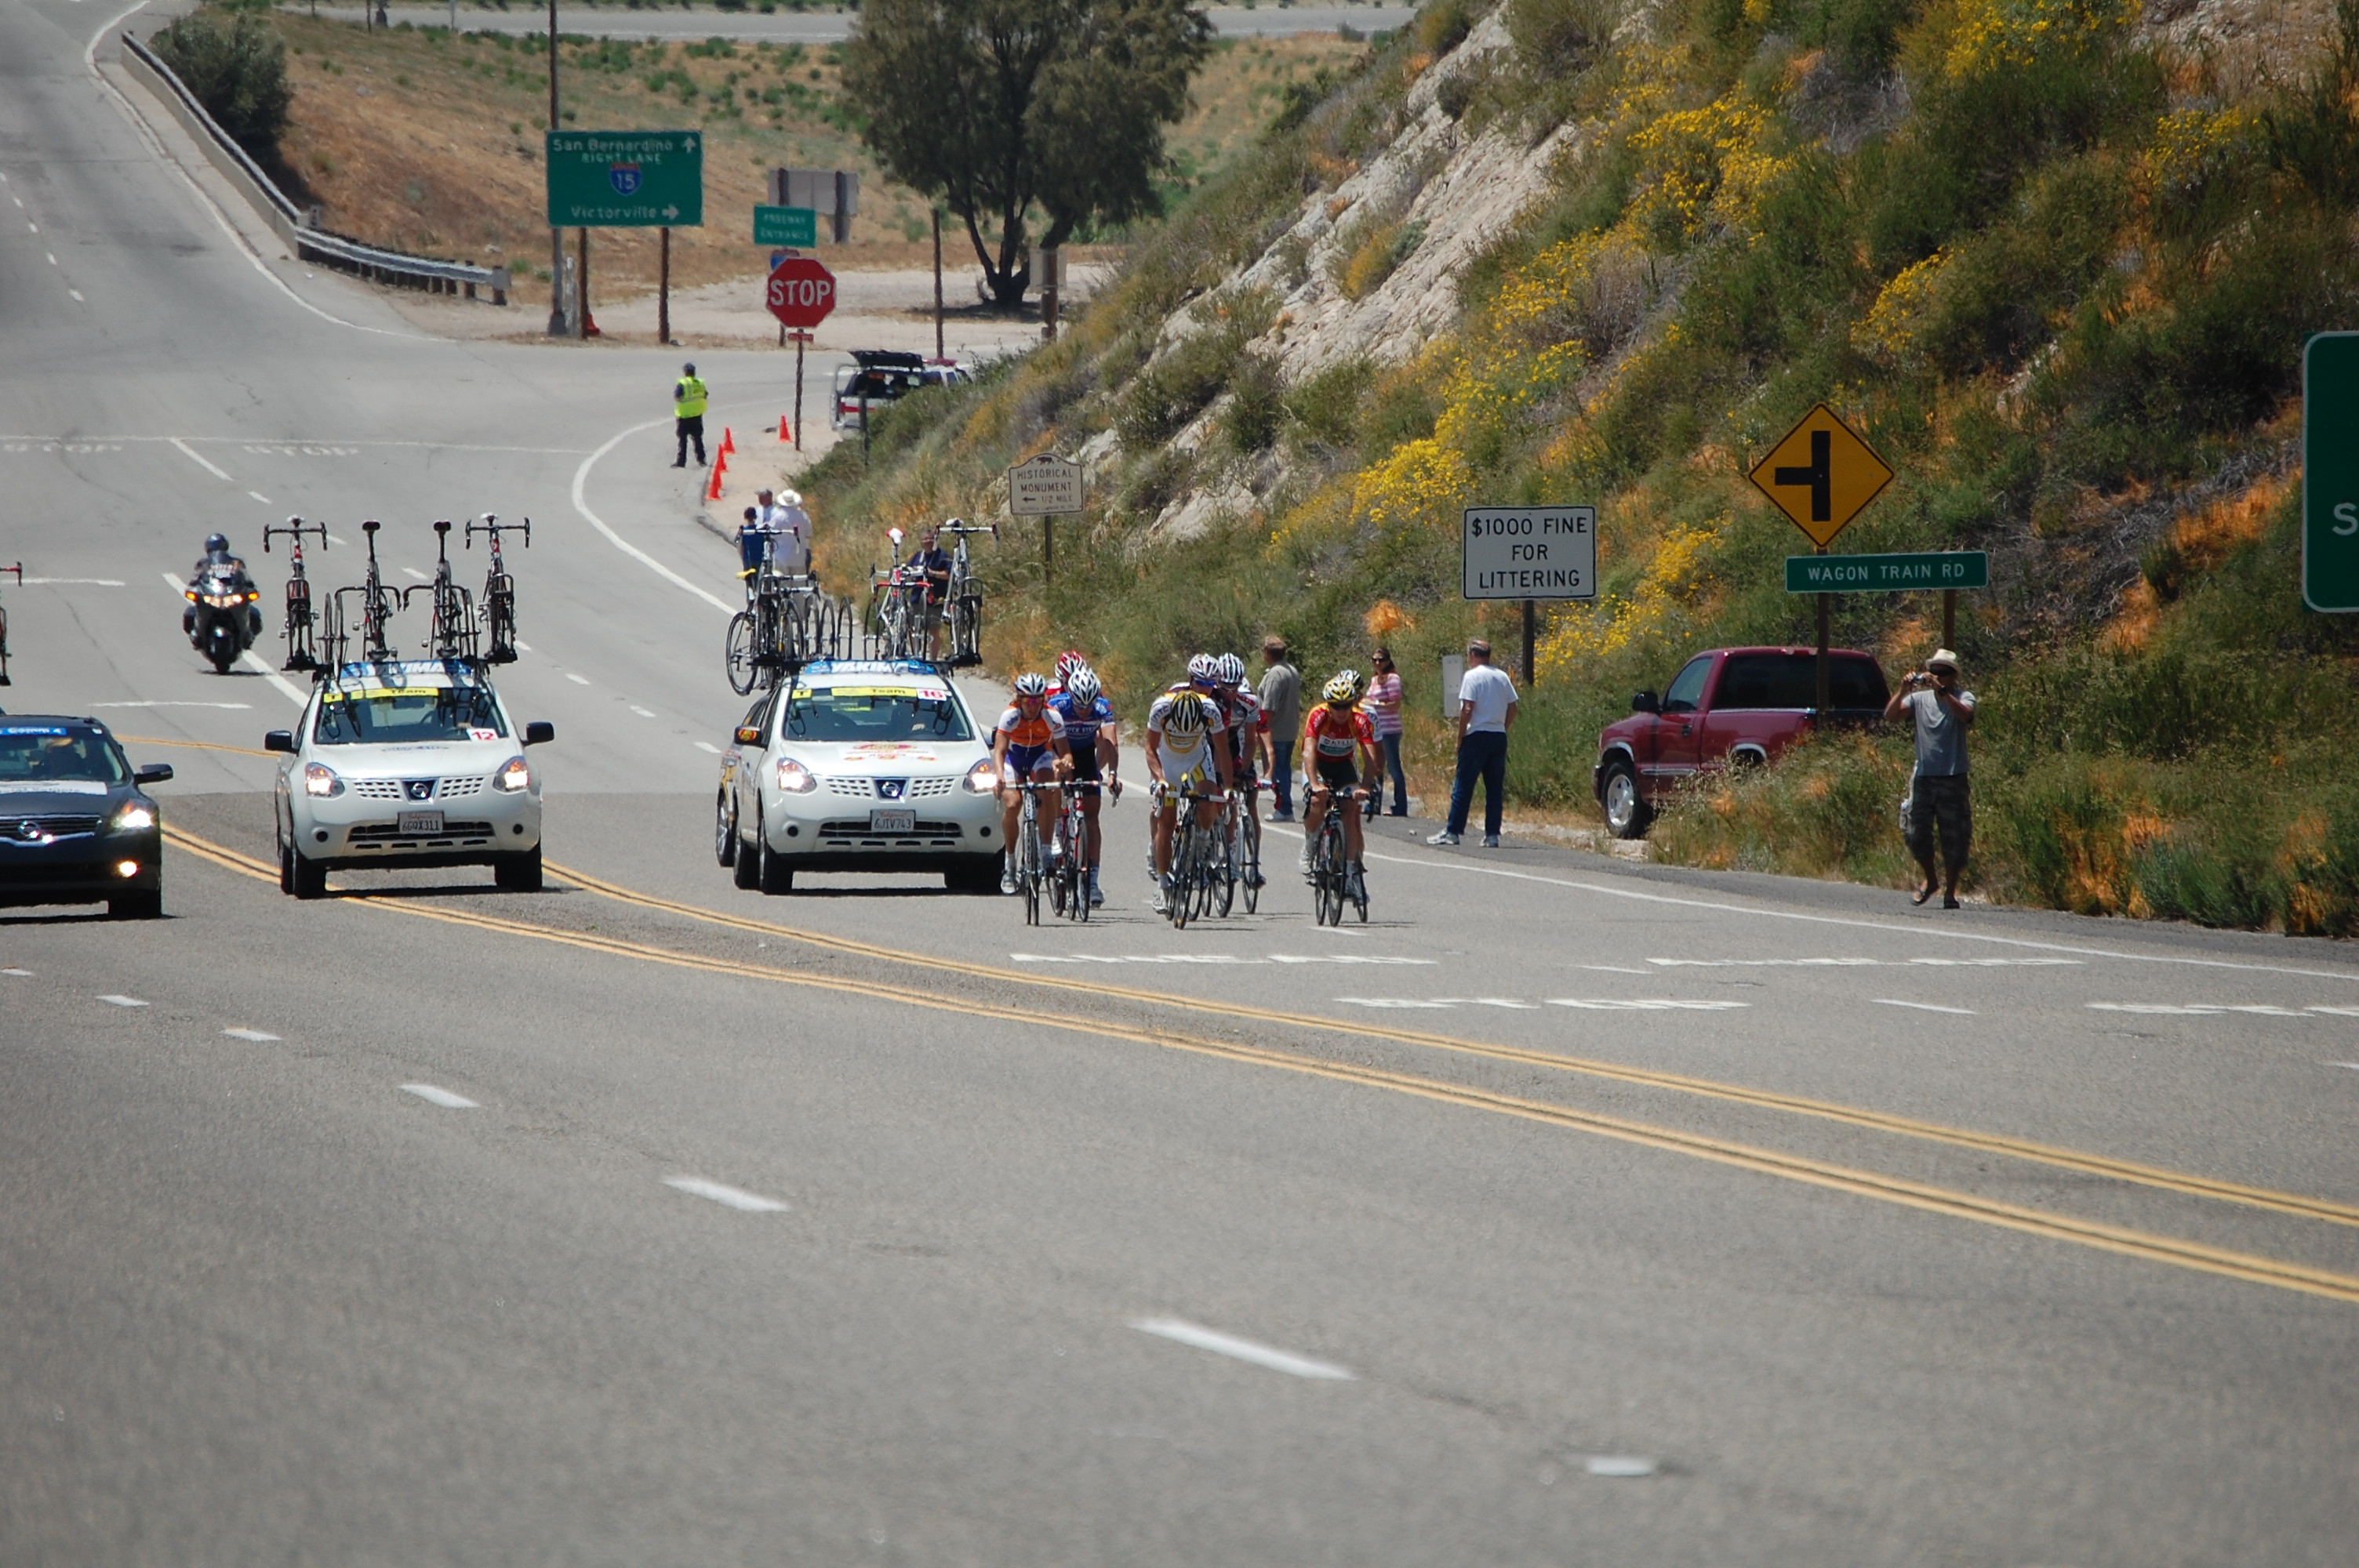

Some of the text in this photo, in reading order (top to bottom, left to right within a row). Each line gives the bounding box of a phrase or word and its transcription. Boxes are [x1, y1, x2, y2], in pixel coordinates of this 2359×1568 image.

[553, 138, 673, 151] San Bernardino
[581, 152, 662, 164] RIGHT LANE
[617, 173, 635, 190] 15
[571, 206, 656, 219] Victorville
[764, 214, 805, 224] FREEWAY
[761, 228, 809, 240] ENTRANCE
[770, 279, 831, 307] STOP
[1017, 469, 1073, 480] HISTORICAL
[1021, 482, 1071, 493] MONUMENT
[1472, 517, 1587, 538] $1000 FINE
[1512, 544, 1548, 561] FOR
[1808, 563, 1965, 581] WAGON TRAIN RD
[1479, 569, 1580, 589] LITTERING
[919, 689, 943, 699] 16
[471, 731, 495, 740] 12
